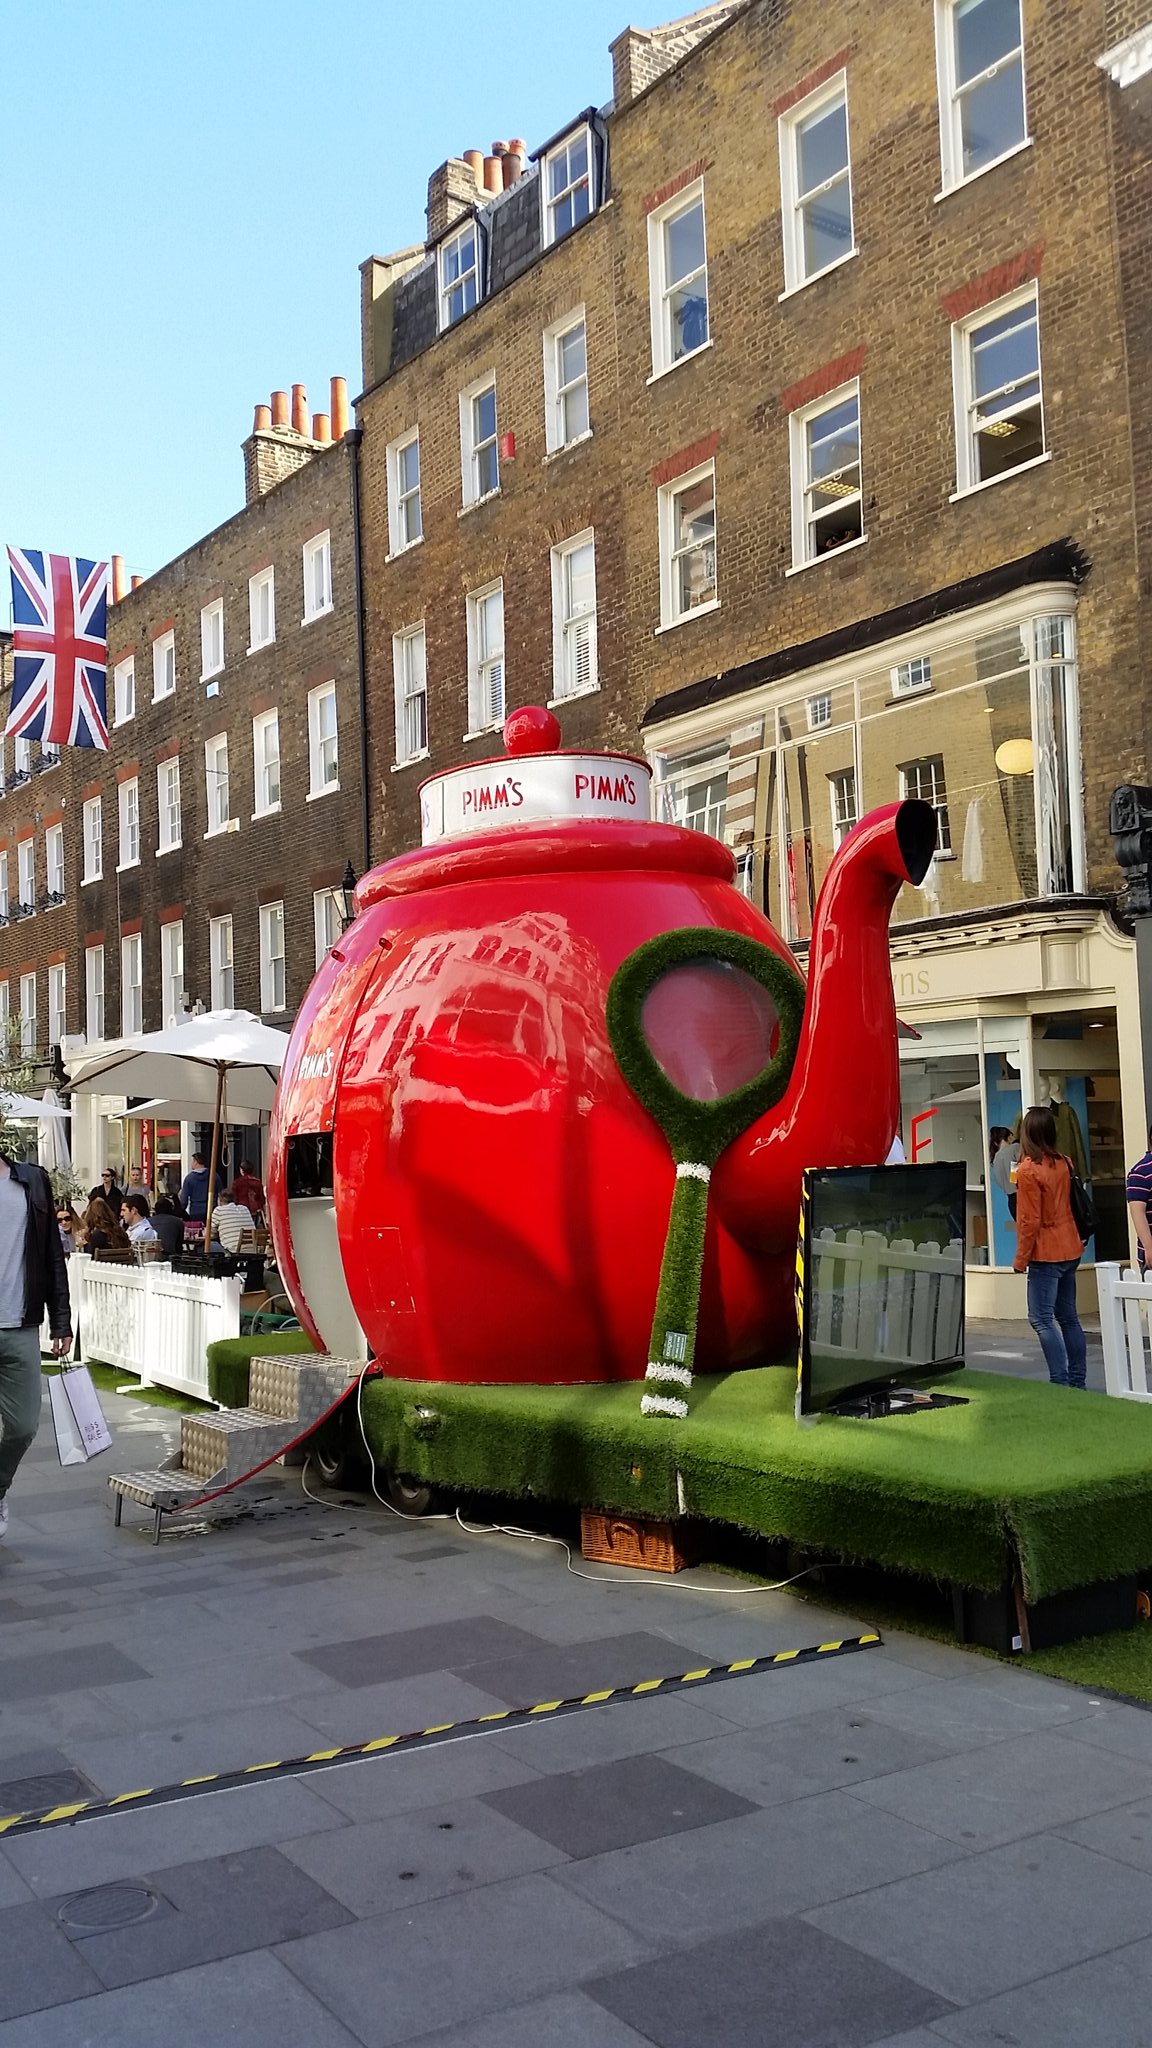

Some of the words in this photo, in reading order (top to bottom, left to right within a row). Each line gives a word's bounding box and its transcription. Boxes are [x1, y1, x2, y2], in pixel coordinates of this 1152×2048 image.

[462, 777, 524, 815] PIMM'S
[575, 774, 636, 805] PIMM'S
[893, 970, 930, 996] ns
[298, 1047, 335, 1080] PIMM'S
[142, 1119, 150, 1185] SALE
